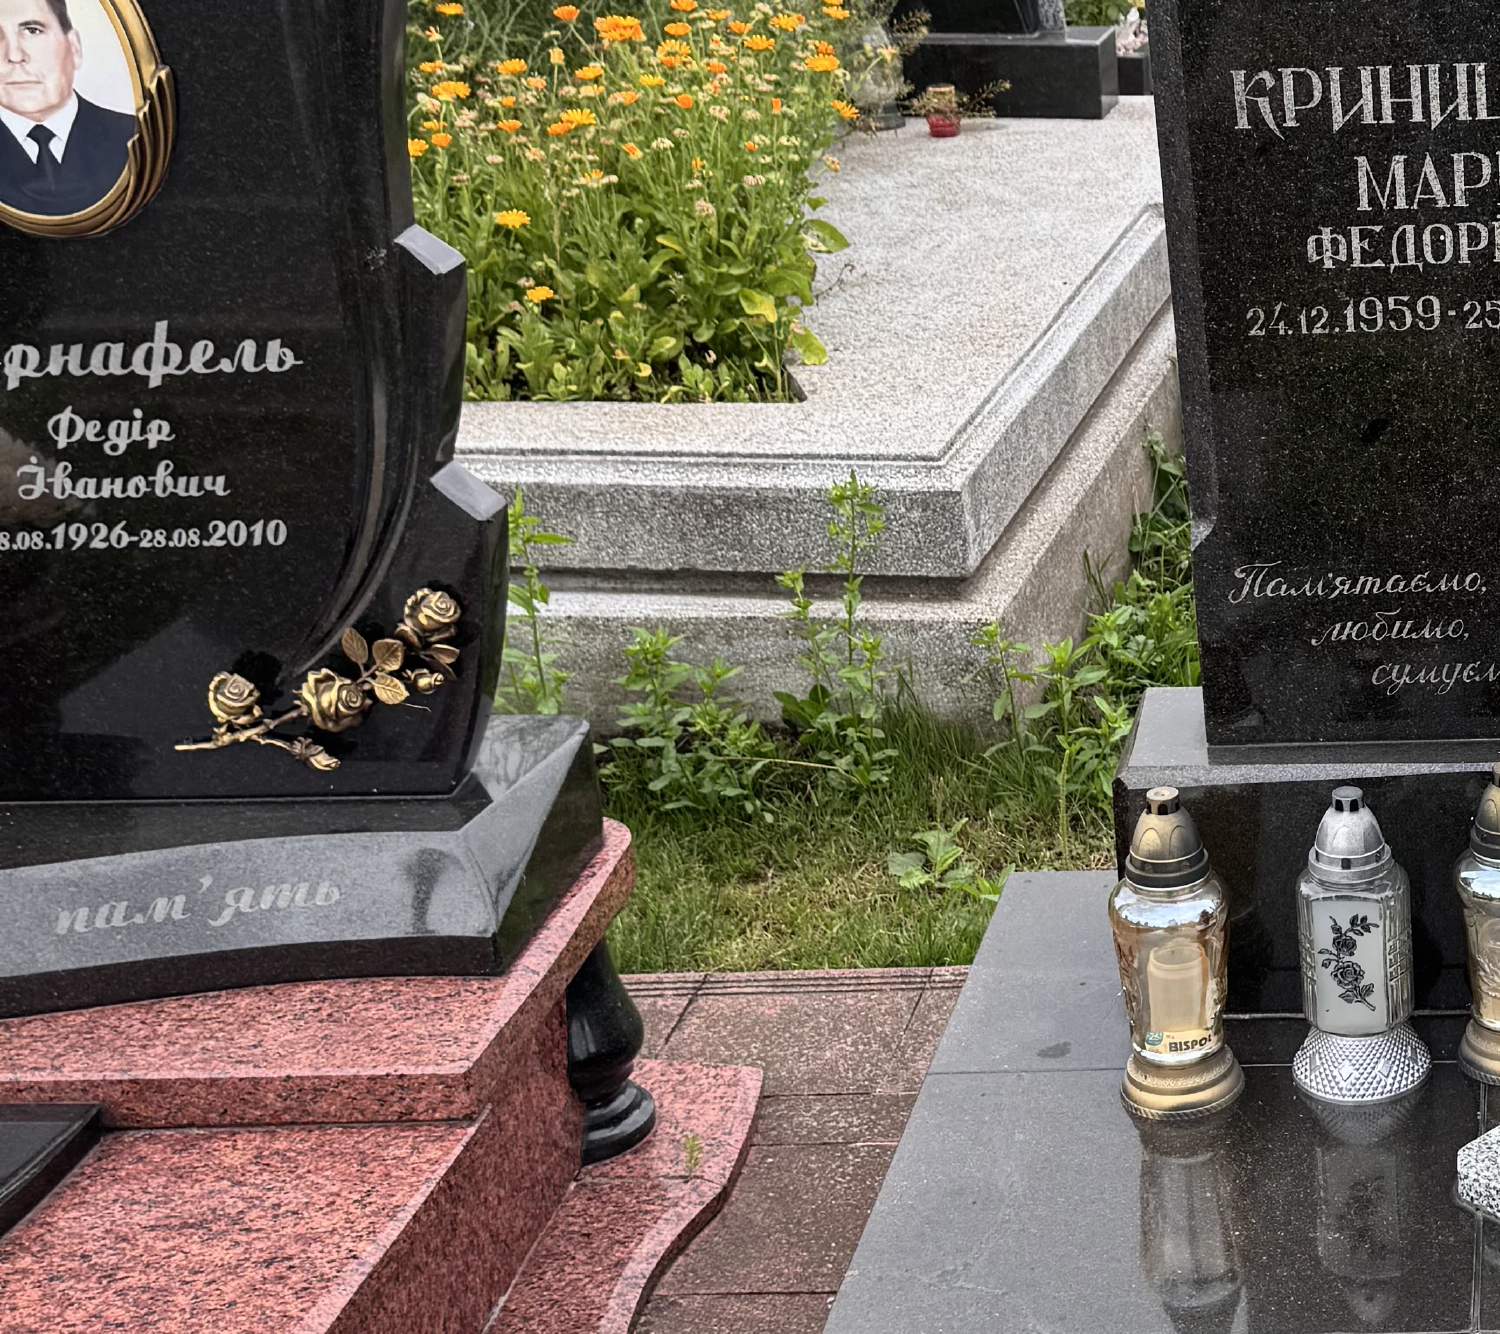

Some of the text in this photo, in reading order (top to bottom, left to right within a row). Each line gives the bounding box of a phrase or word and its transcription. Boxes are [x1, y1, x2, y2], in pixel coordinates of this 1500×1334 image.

[0, 320, 304, 391] рнафель
[47, 405, 176, 457] Федір
[16, 456, 231, 501] Іванович
[1310, 607, 1470, 647] любимо,
[54, 874, 342, 935] пам'ять
